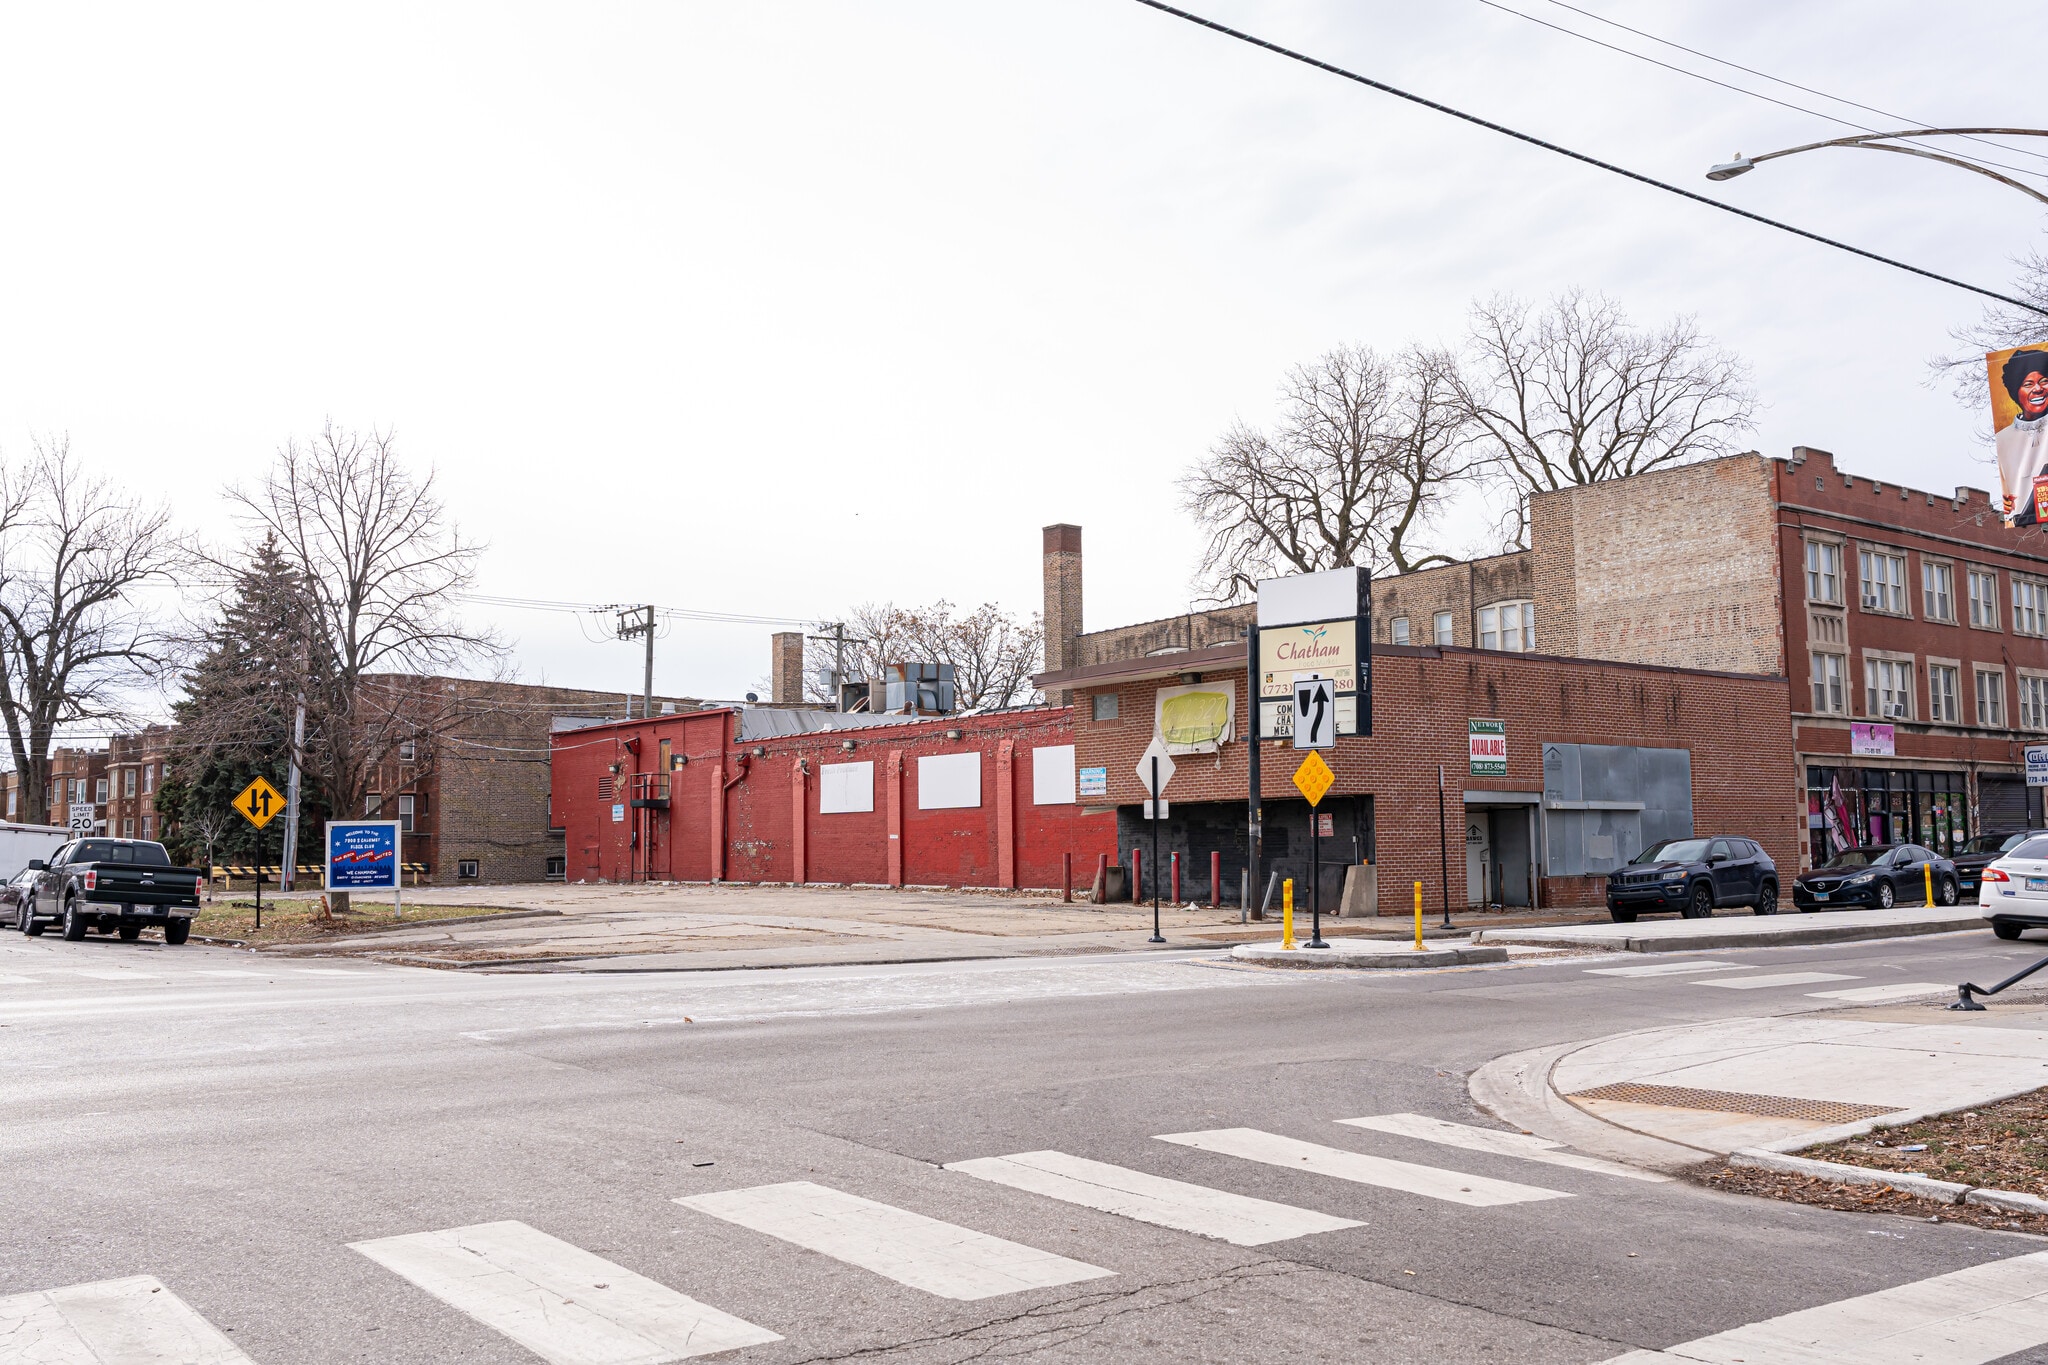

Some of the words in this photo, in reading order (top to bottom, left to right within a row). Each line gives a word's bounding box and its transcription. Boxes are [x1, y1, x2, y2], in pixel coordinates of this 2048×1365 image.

[1277, 639, 1340, 660] Chatham
[1262, 683, 1293, 695] (773)
[1276, 705, 1293, 714] COM
[1276, 715, 1294, 725] CHA
[1273, 725, 1294, 736] MEA
[1470, 721, 1504, 732] NETWORK
[1471, 739, 1505, 756] AVAILABLE
[72, 819, 91, 828] 20
[374, 851, 392, 860] UNITED
